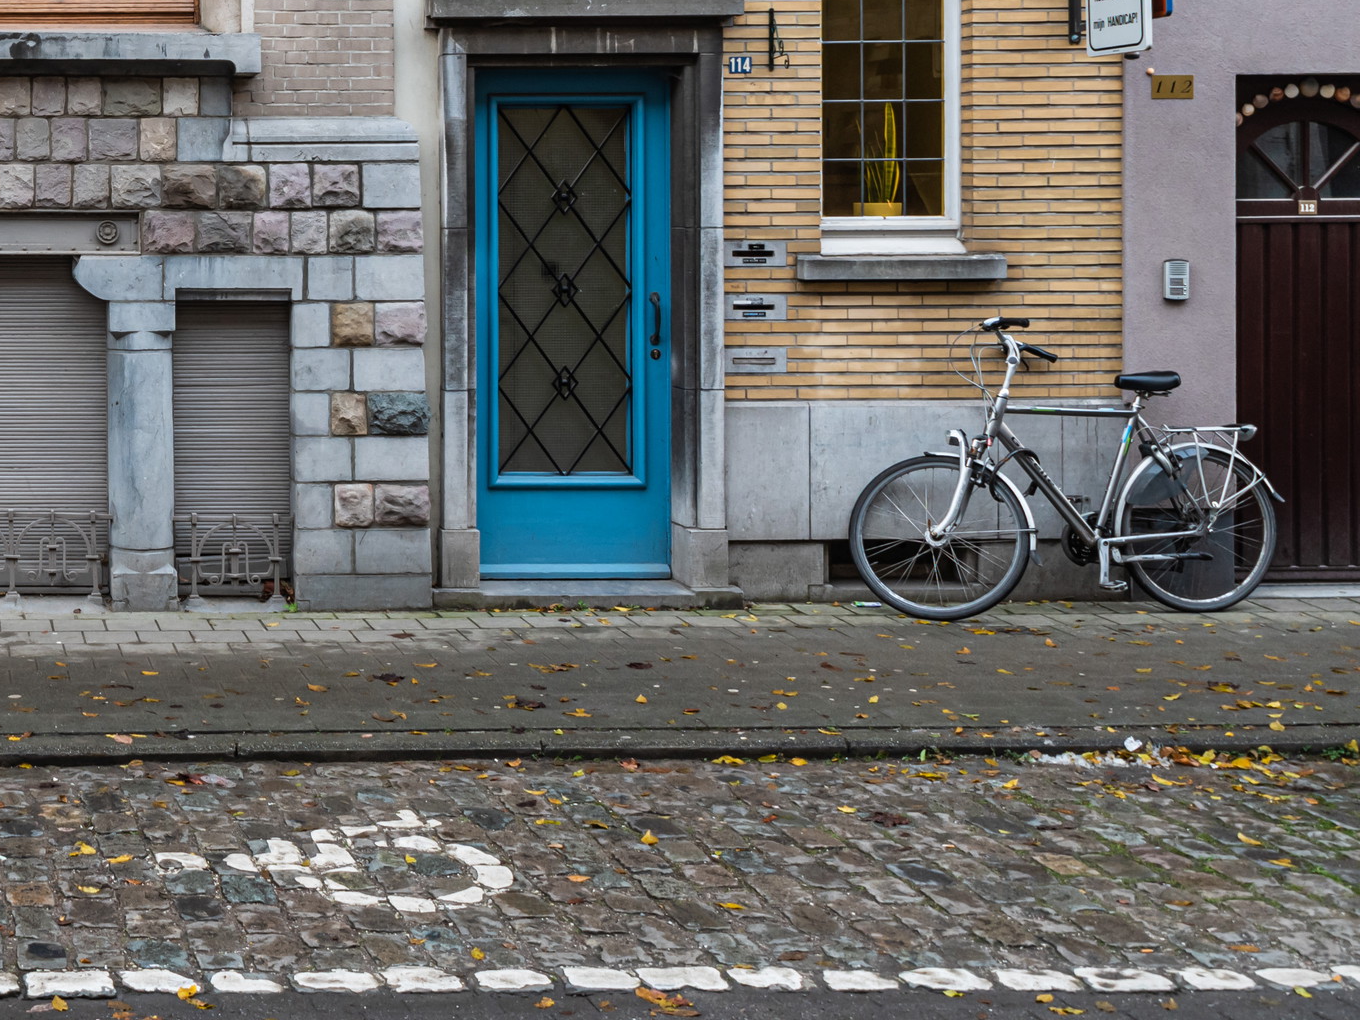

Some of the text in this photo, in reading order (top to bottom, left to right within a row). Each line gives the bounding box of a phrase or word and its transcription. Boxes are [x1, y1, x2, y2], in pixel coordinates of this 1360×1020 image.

[1107, 12, 1138, 27] HANDICAP!
[730, 57, 751, 72] 114
[1156, 80, 1192, 93] 112
[1300, 203, 1315, 212] 112
